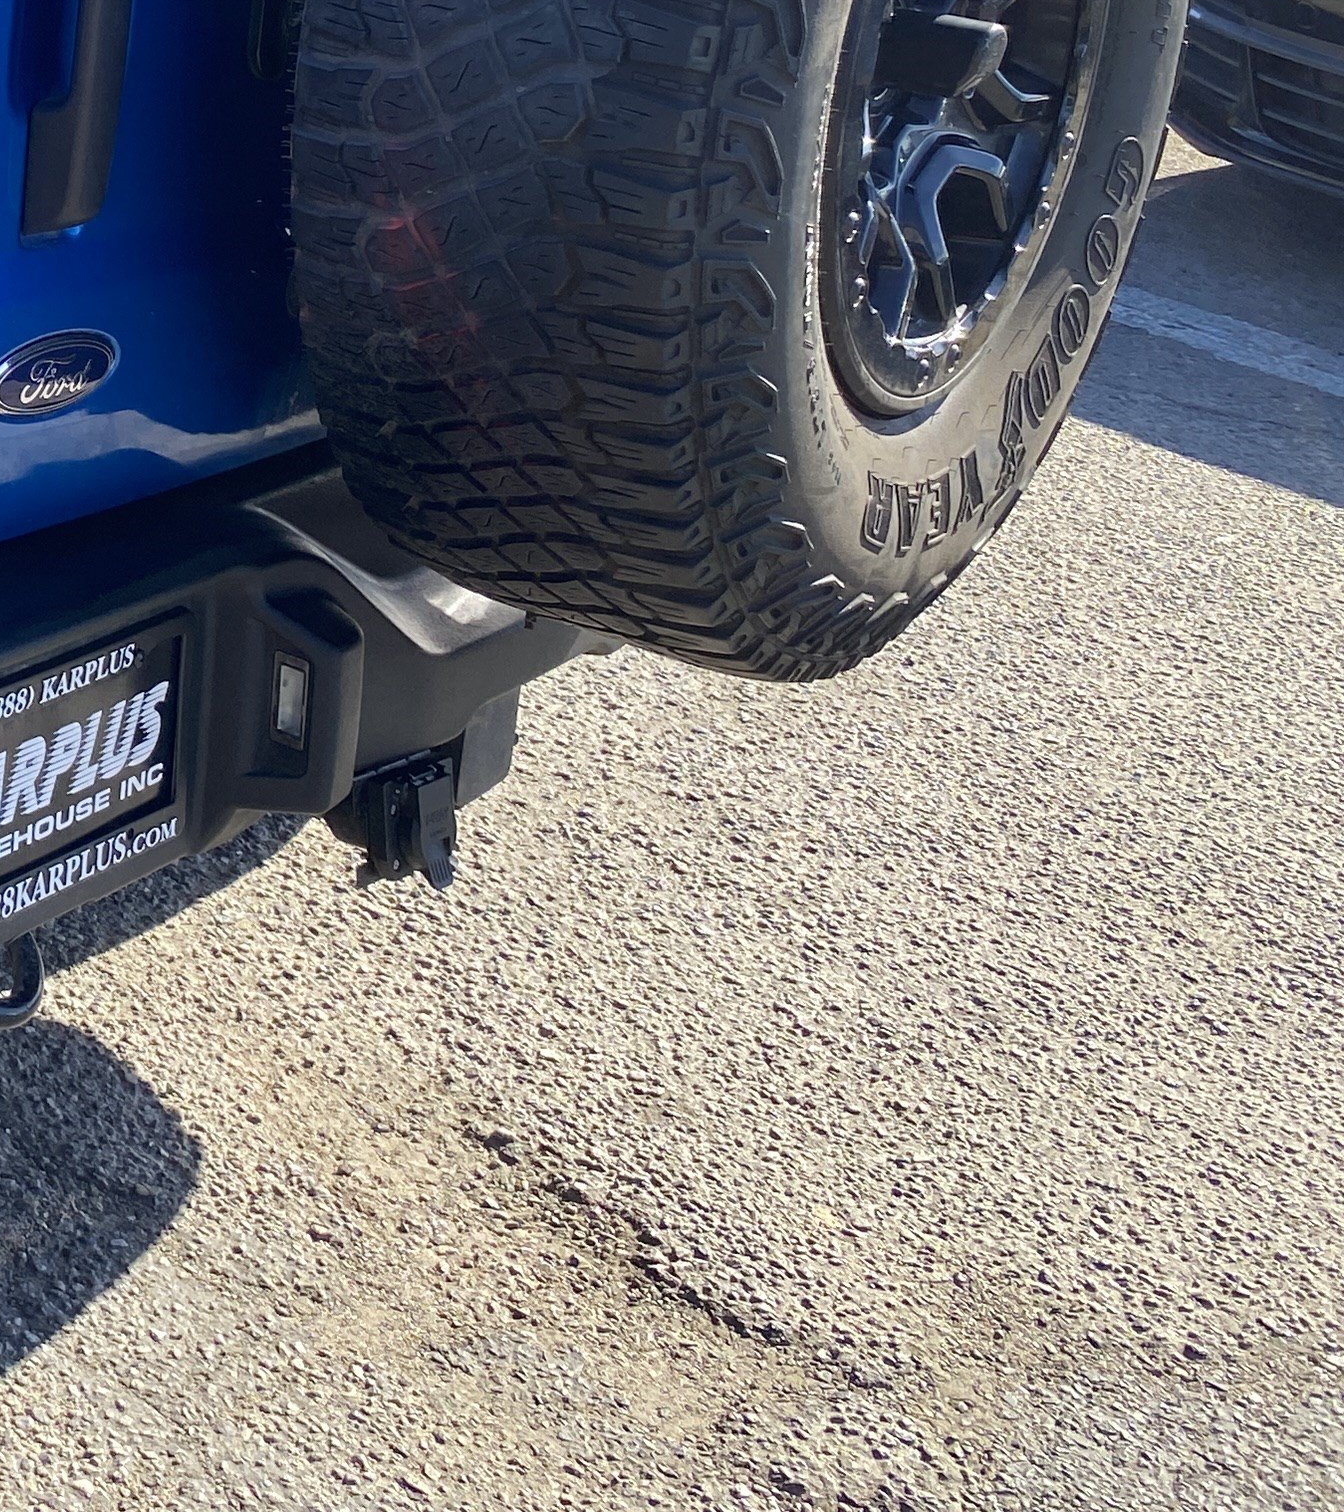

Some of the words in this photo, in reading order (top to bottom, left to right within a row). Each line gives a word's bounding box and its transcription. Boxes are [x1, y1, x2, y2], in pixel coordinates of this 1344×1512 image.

[20, 353, 92, 405] Ford
[39, 643, 136, 705] KARPLUS
[120, 762, 164, 800] INC
